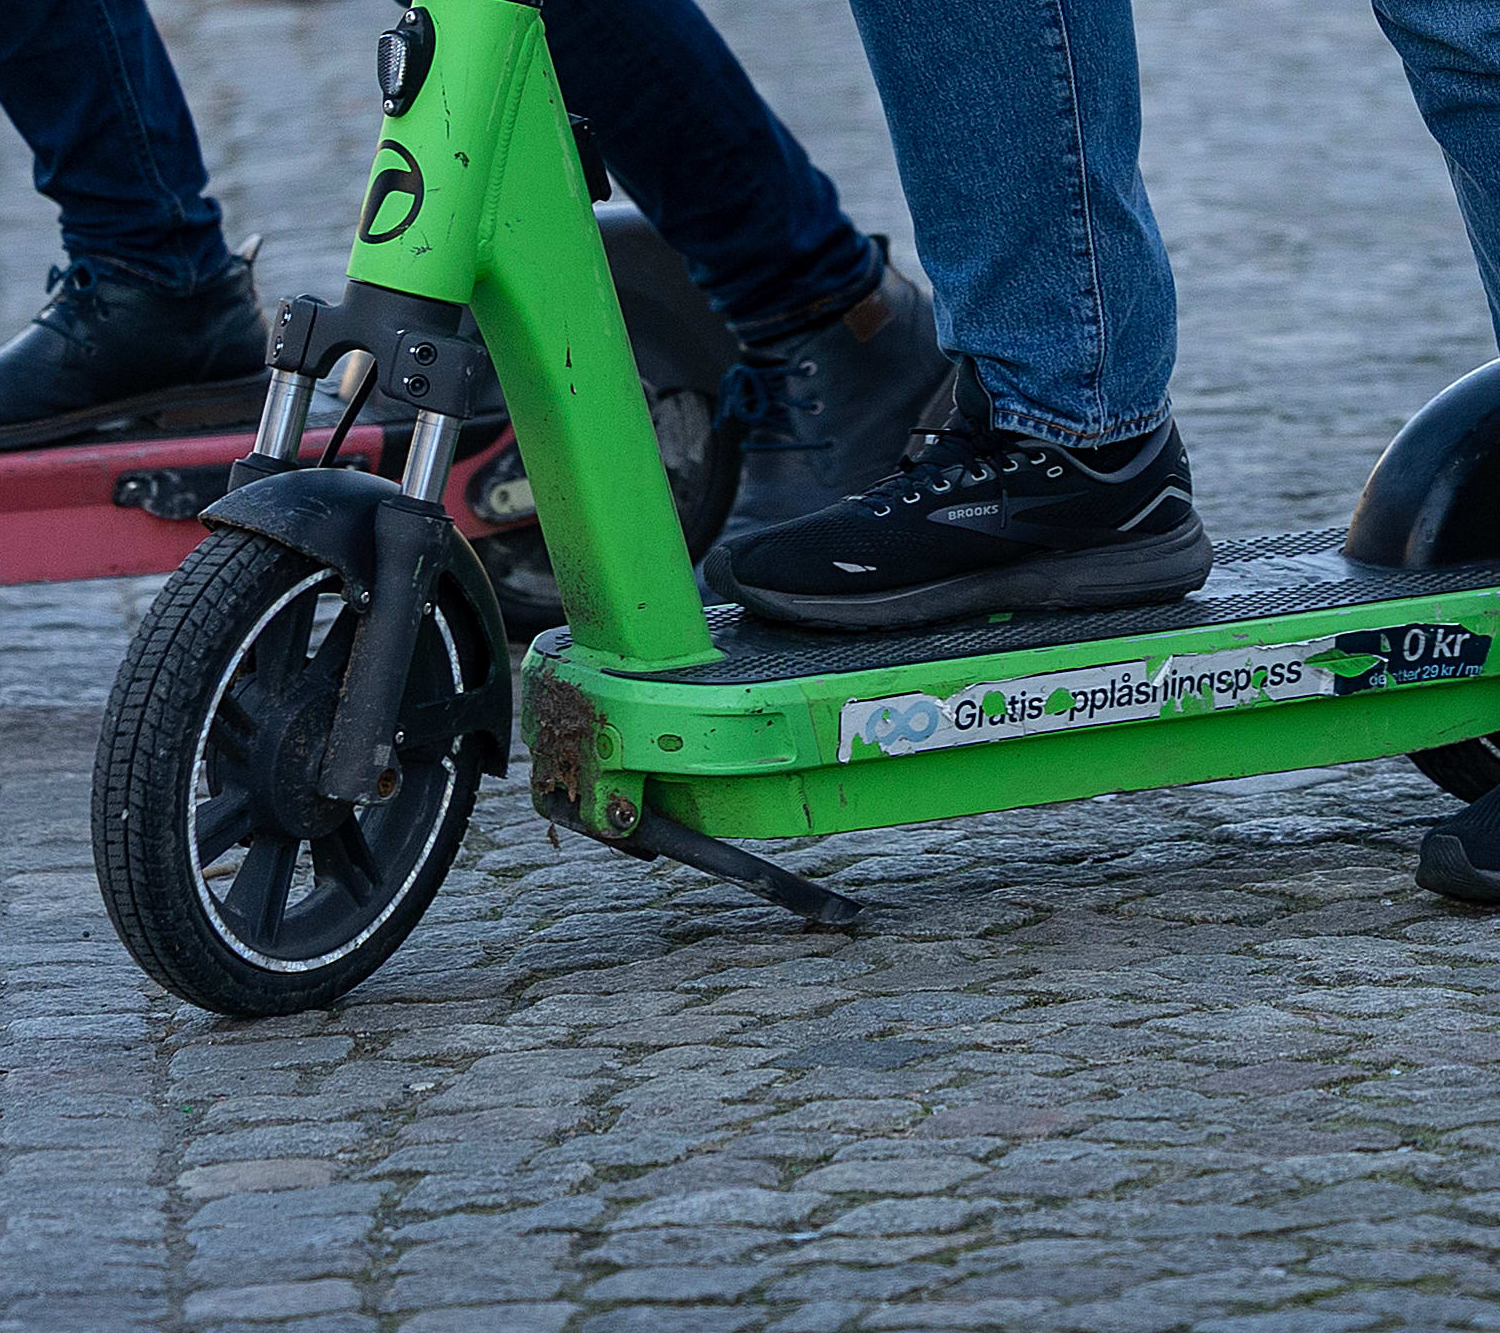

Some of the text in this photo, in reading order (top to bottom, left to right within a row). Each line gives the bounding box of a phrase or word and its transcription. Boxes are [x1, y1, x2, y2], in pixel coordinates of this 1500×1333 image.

[947, 504, 999, 521] BROOKS
[1403, 627, 1471, 662] 0 kr
[1422, 664, 1439, 679] 29
[1440, 663, 1456, 677] kr
[1052, 659, 1302, 720] pplåsningspass
